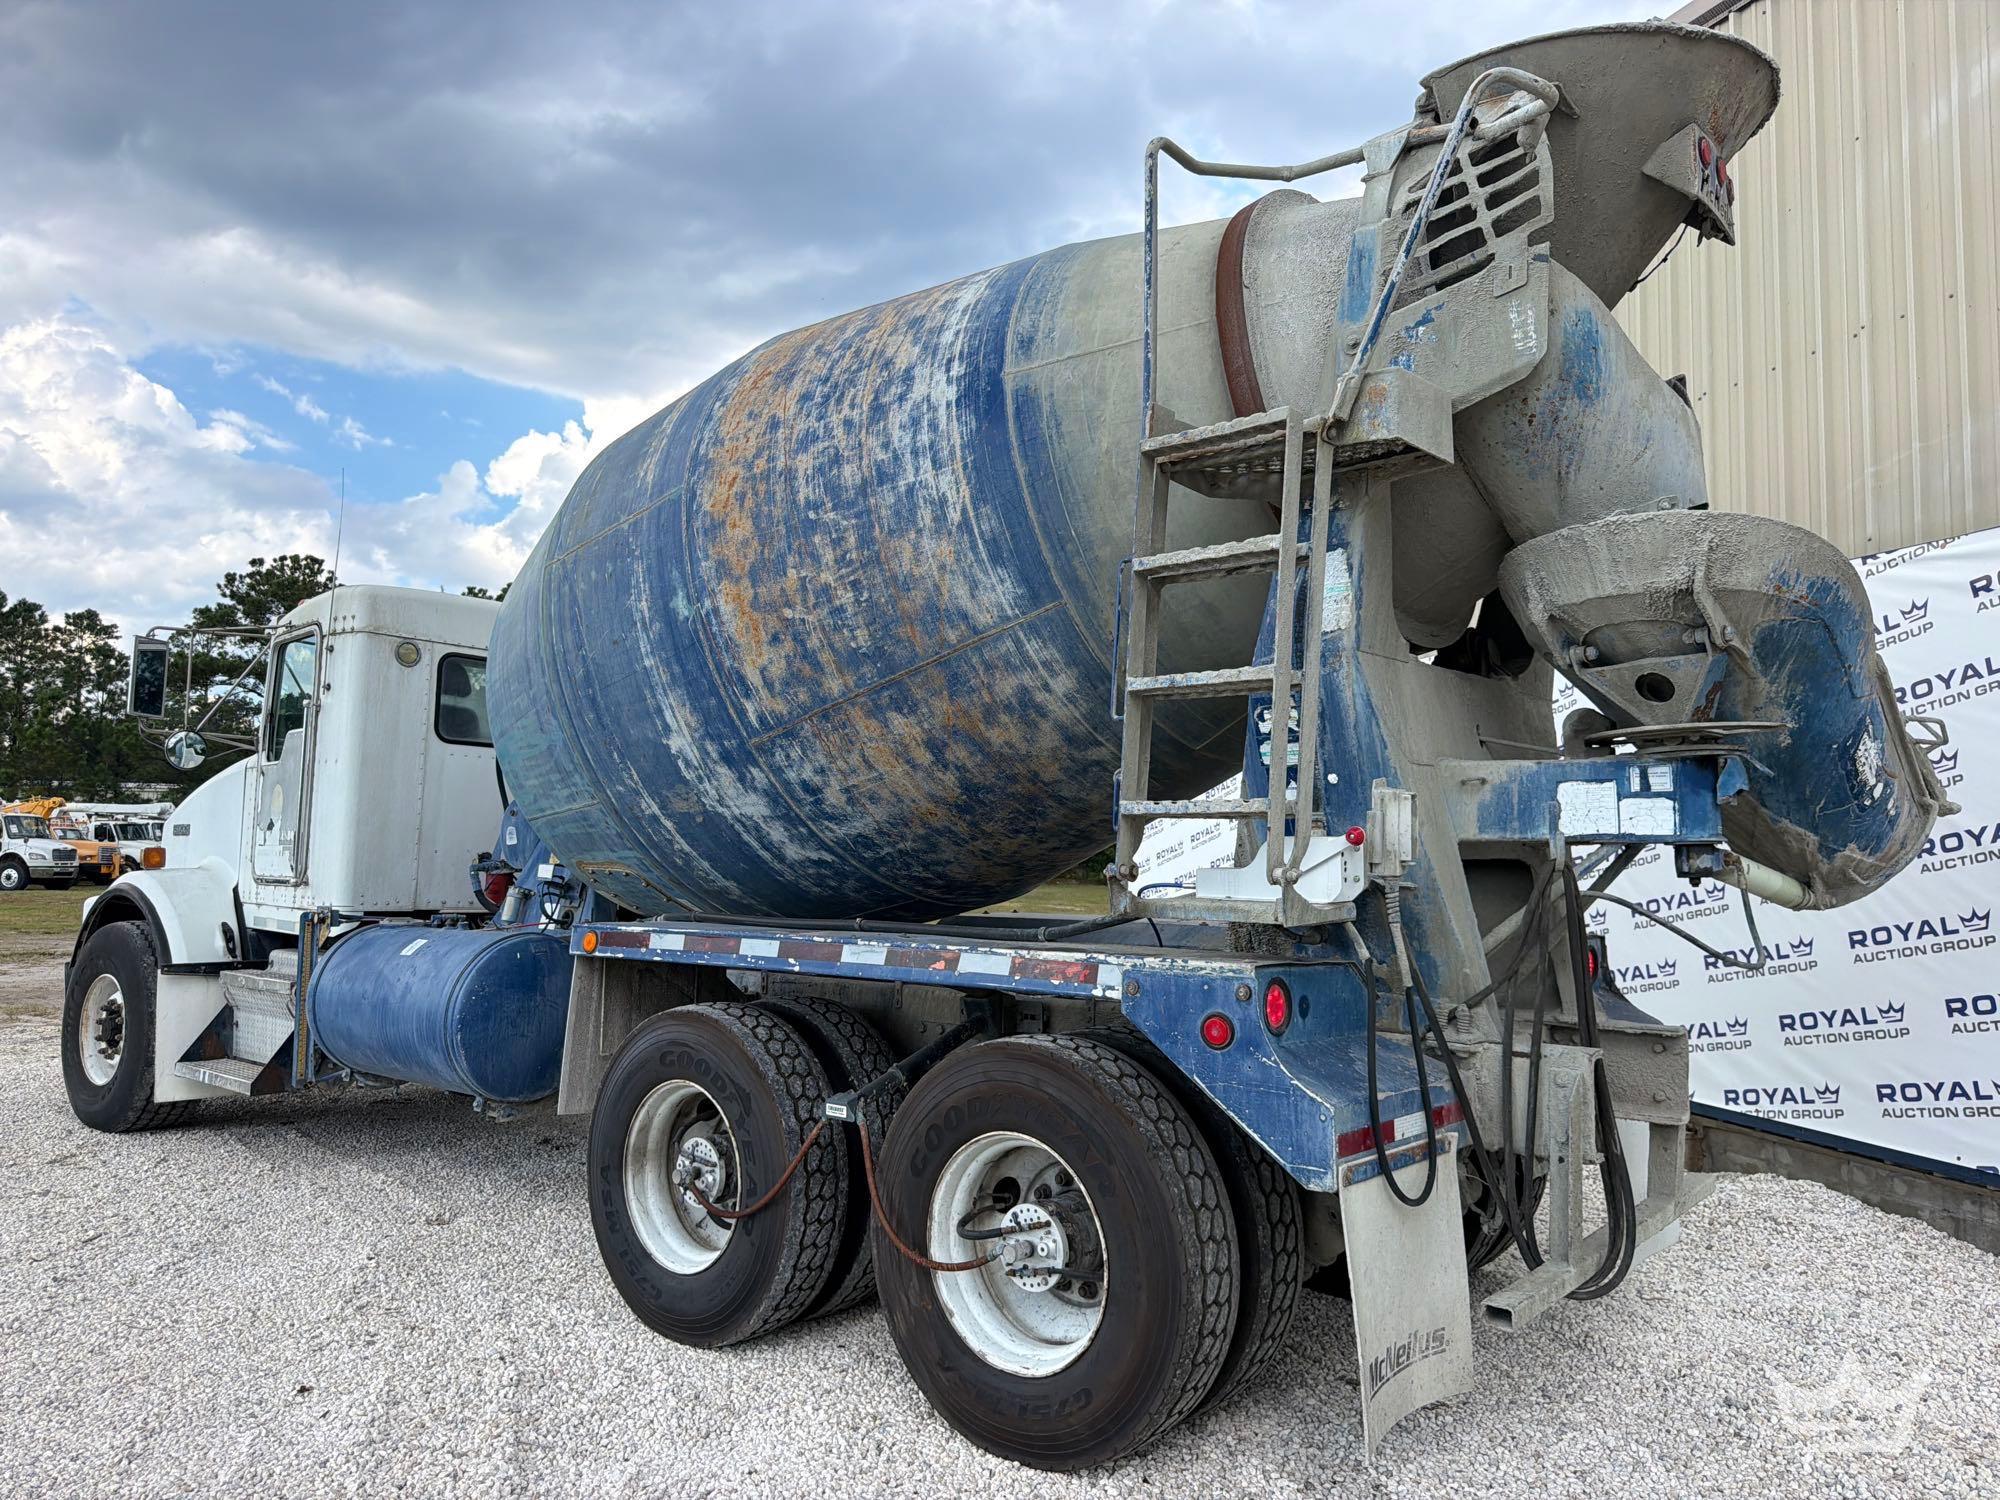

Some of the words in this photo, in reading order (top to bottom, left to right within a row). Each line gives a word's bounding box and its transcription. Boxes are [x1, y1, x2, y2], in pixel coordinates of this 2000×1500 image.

[1865, 540, 1940, 579] AUCTION
[1875, 621, 1934, 651] GROUP
[1902, 690, 1971, 717] UCTION
[1190, 825, 1215, 843] ROYAL
[1156, 844, 1178, 861] ROYAL
[1686, 904, 1730, 921] GROUP
[1847, 917, 1960, 949] ROYAL
[1853, 945, 1928, 965] AUCTION
[1930, 935, 1997, 954] GROUP
[1611, 964, 1658, 983] YAL
[1707, 967, 1765, 984] AUCTION
[1768, 960, 1818, 976] GROUP
[1640, 979, 1680, 993] GROUP
[1779, 1007, 1878, 1032] ROYAL
[1951, 1020, 2000, 1035] AUCT
[1684, 1021, 1727, 1040] YAL
[1783, 1032, 1850, 1047] AUCTION
[1852, 1027, 1911, 1042] GROUP
[1707, 1039, 1752, 1053] GROUP
[1723, 1086, 1816, 1106] ROYAL
[1876, 1081, 1994, 1103] ROYAL
[1791, 1108, 1845, 1120] GROUP
[1881, 1106, 1959, 1118] AUCTION
[1962, 1106, 2000, 1118] GRO
